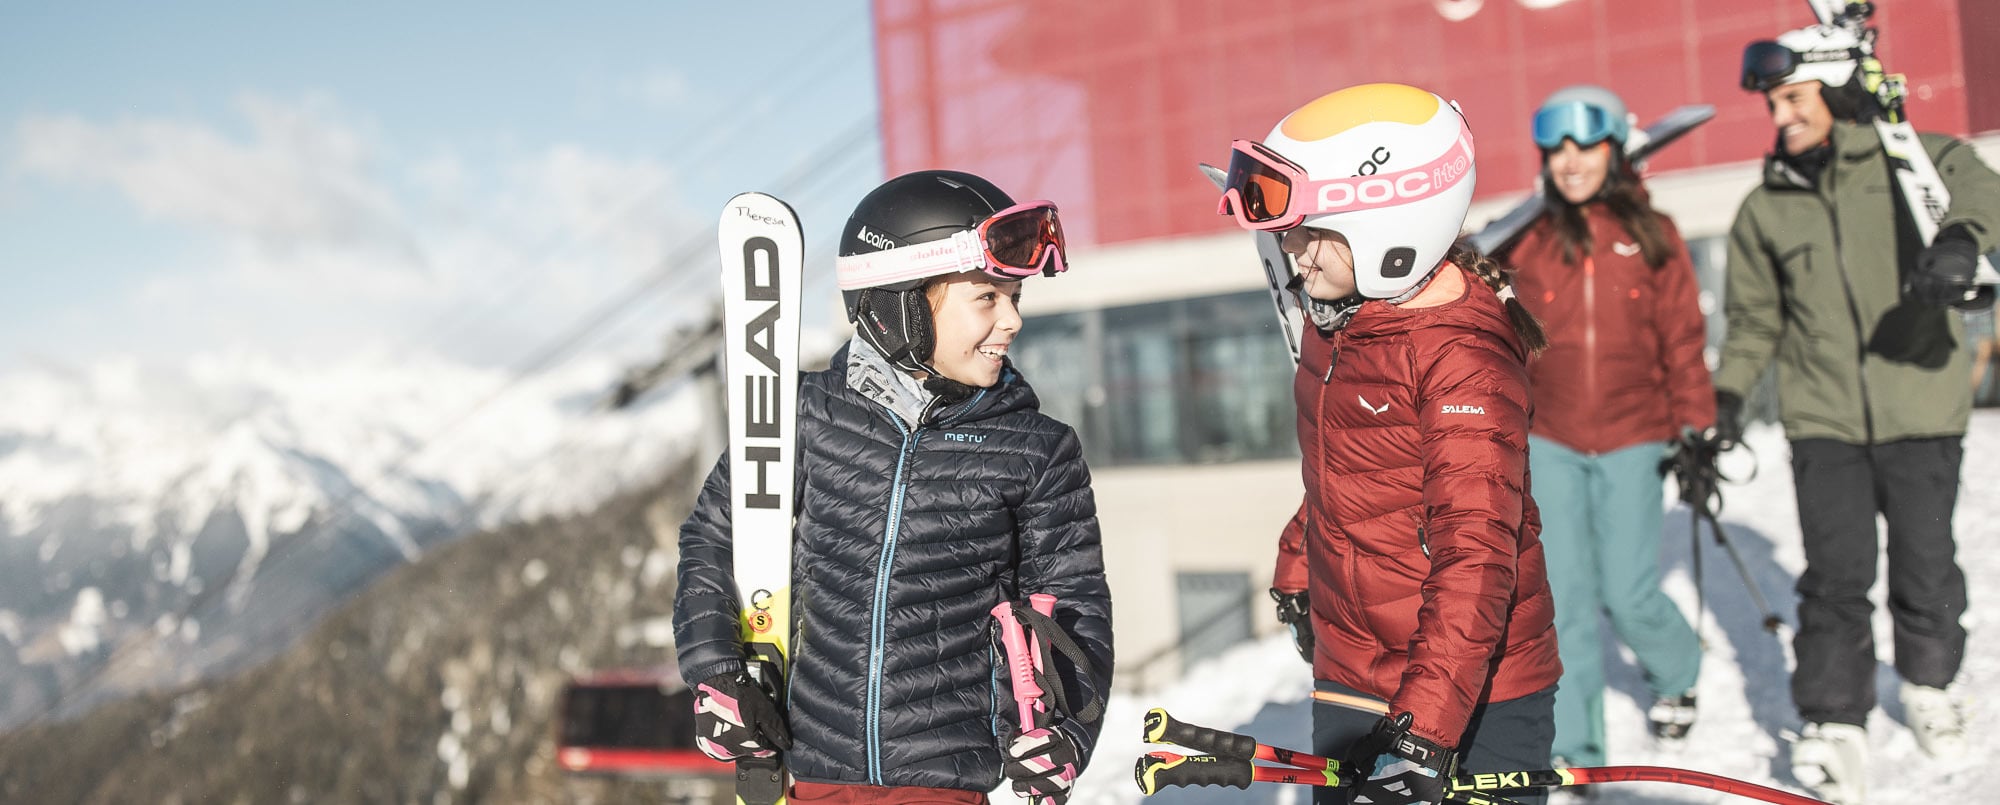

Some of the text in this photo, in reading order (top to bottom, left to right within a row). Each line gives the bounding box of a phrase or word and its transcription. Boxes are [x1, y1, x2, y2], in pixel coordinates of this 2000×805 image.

[735, 206, 786, 227] Theresa
[743, 236, 781, 509] HEAD
[1441, 404, 1486, 415] SALEWA
[1451, 771, 1530, 792] LEKI
